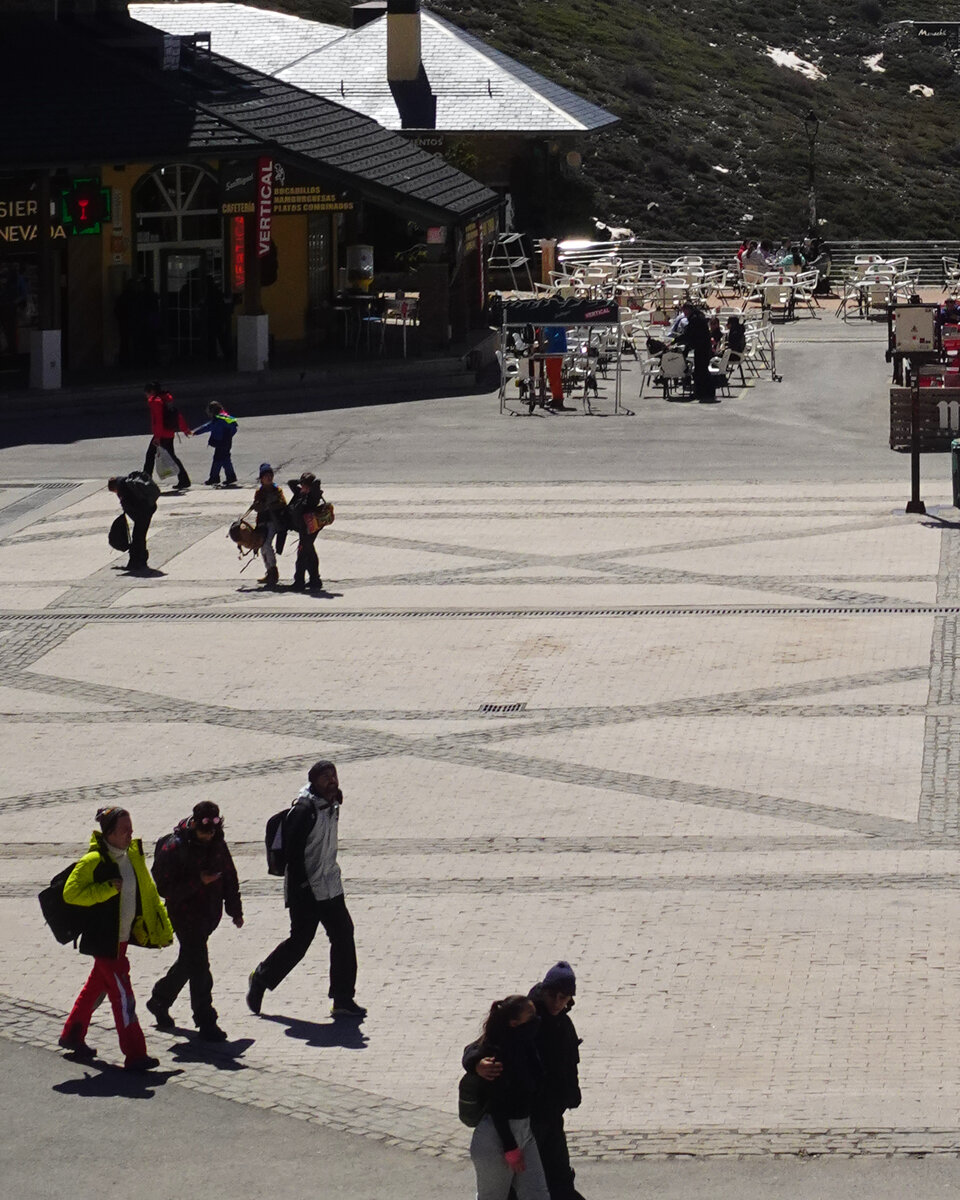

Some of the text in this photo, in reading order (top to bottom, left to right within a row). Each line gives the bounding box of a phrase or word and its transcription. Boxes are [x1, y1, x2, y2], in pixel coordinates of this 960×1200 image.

[411, 137, 443, 146] ENTOS
[273, 185, 321, 195] BOCADILLOS
[273, 194, 336, 204] HAMBURGUESAS
[0, 200, 40, 218] SIER
[258, 160, 274, 255] VERTICAL
[273, 202, 354, 213] PLATOS COMBINADOS
